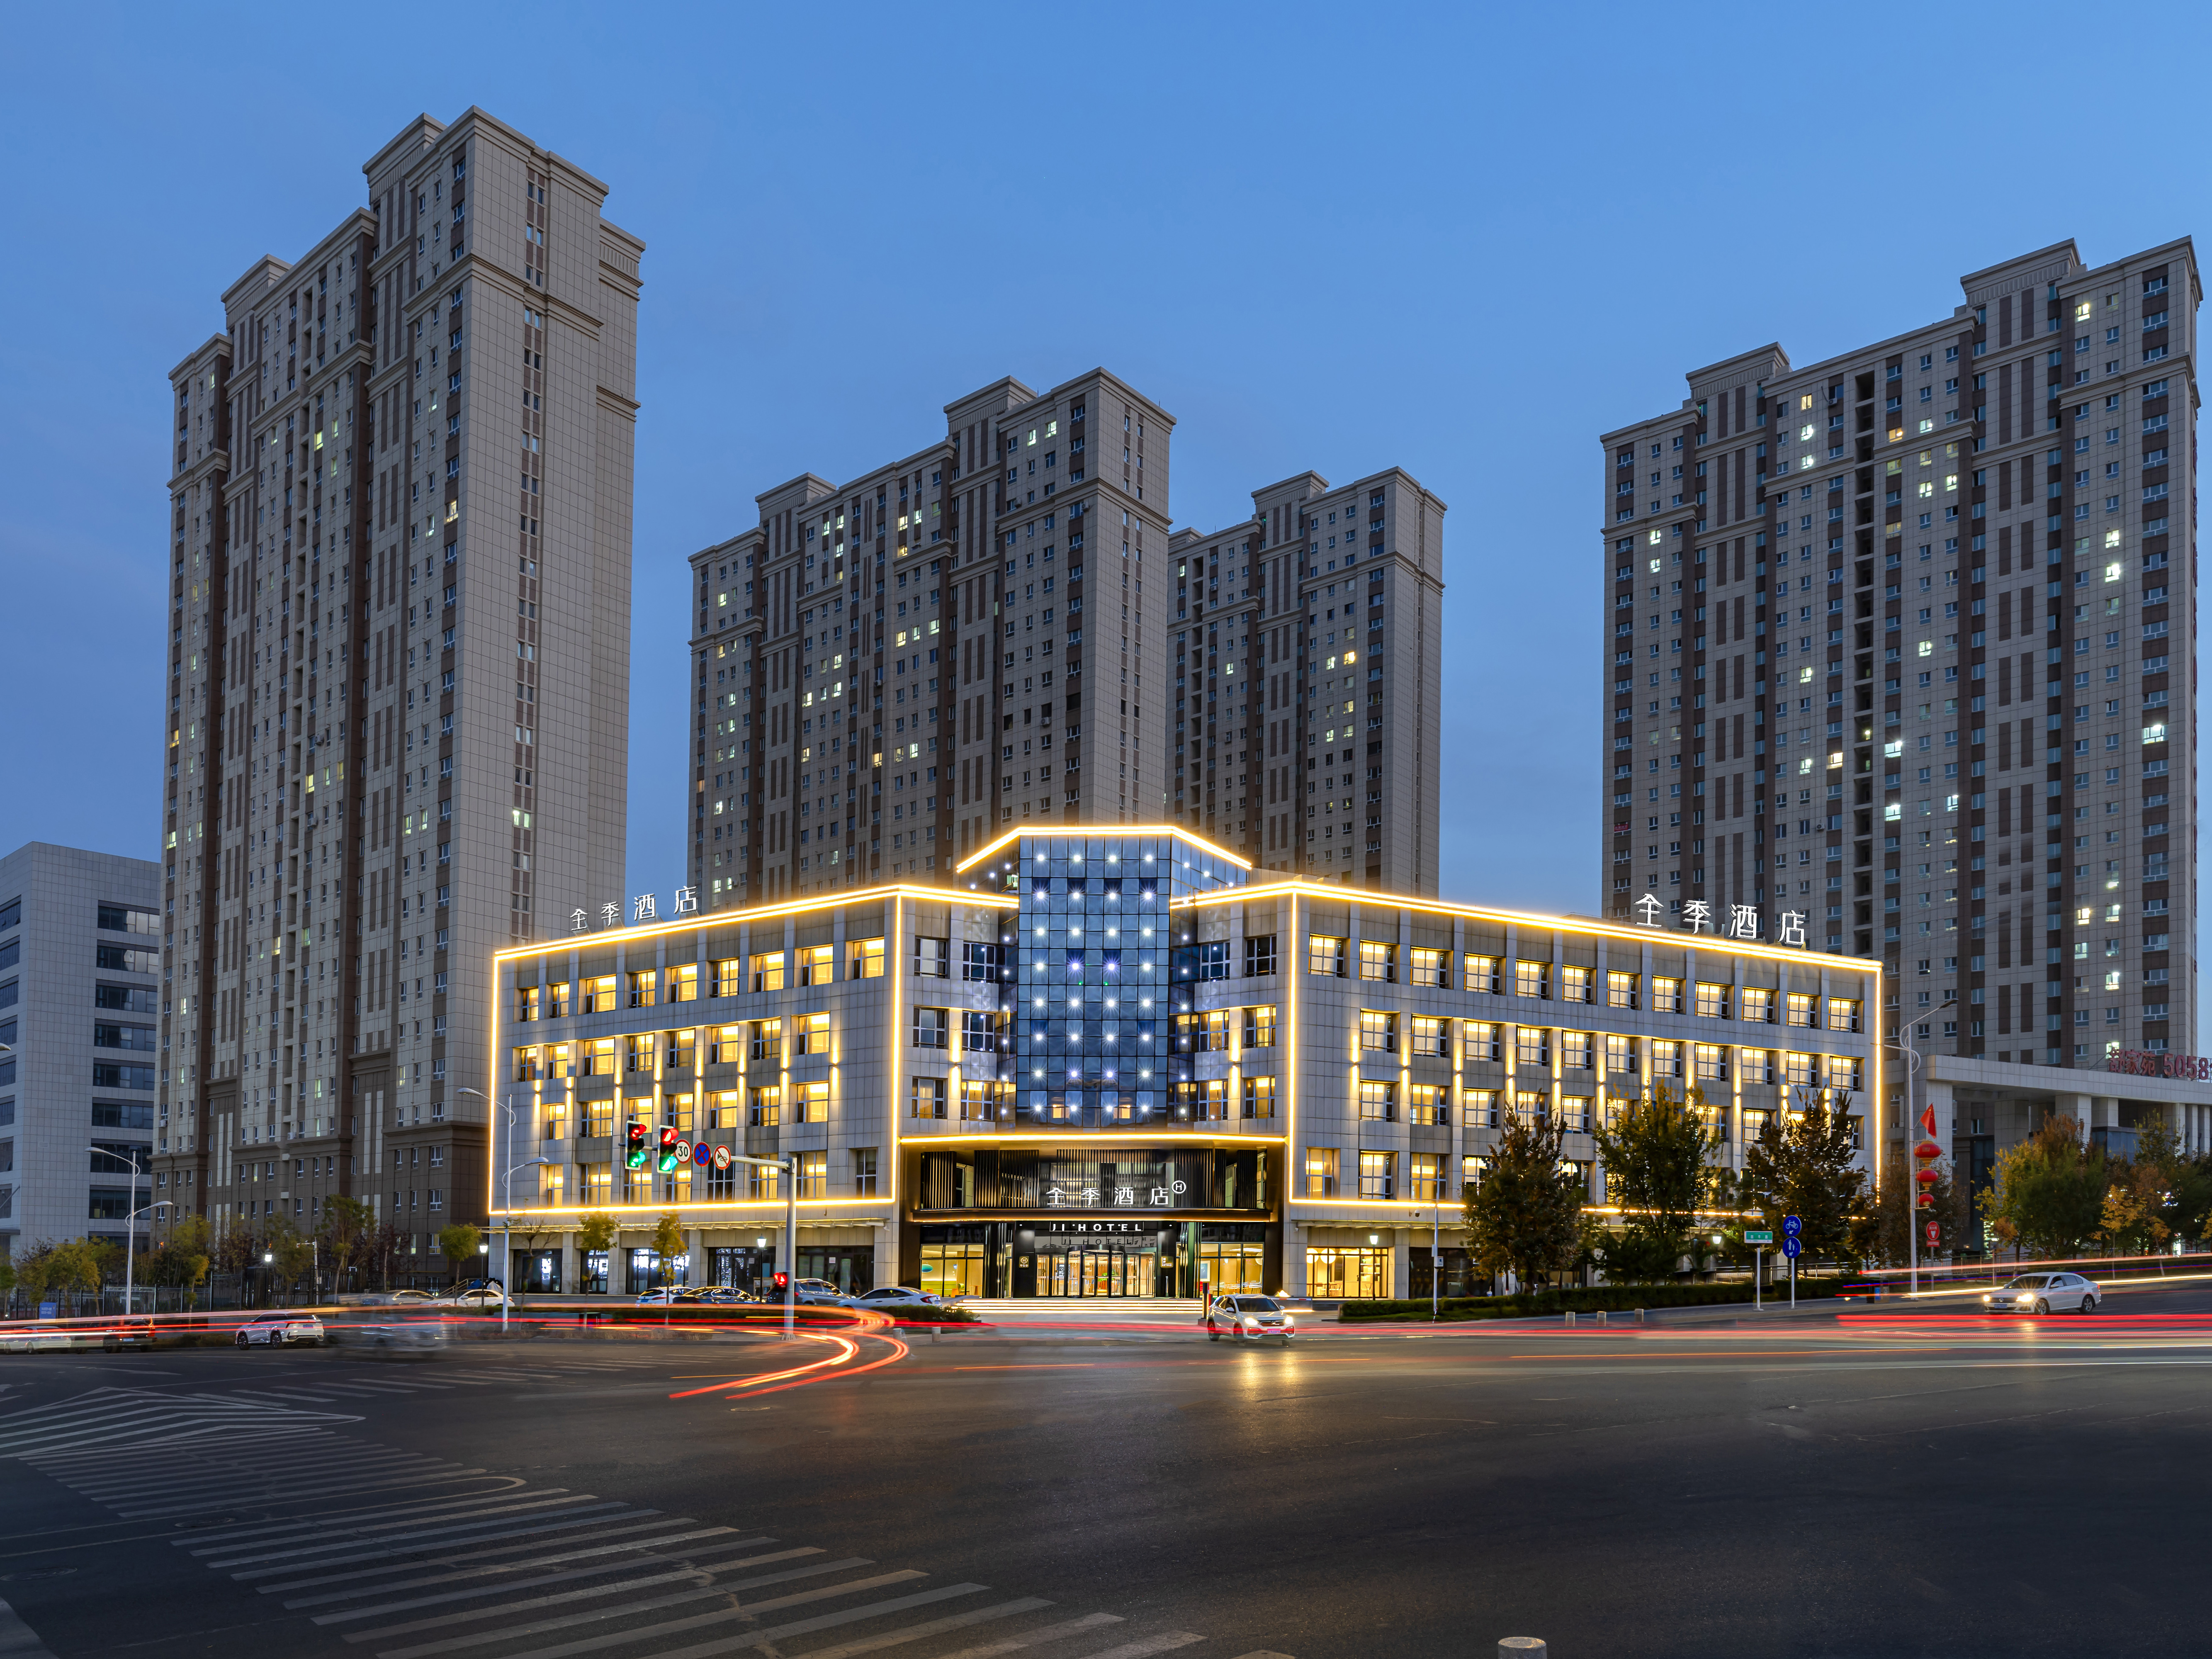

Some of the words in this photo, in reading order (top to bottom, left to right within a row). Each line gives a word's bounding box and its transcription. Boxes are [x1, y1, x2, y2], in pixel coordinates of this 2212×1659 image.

[570, 885, 698, 932] 全季酒店
[1633, 893, 1806, 945] 全季酒店
[2163, 1053, 2212, 1080] 5058
[678, 1146, 688, 1157] 30
[1046, 1187, 1169, 1206] 全季酒店
